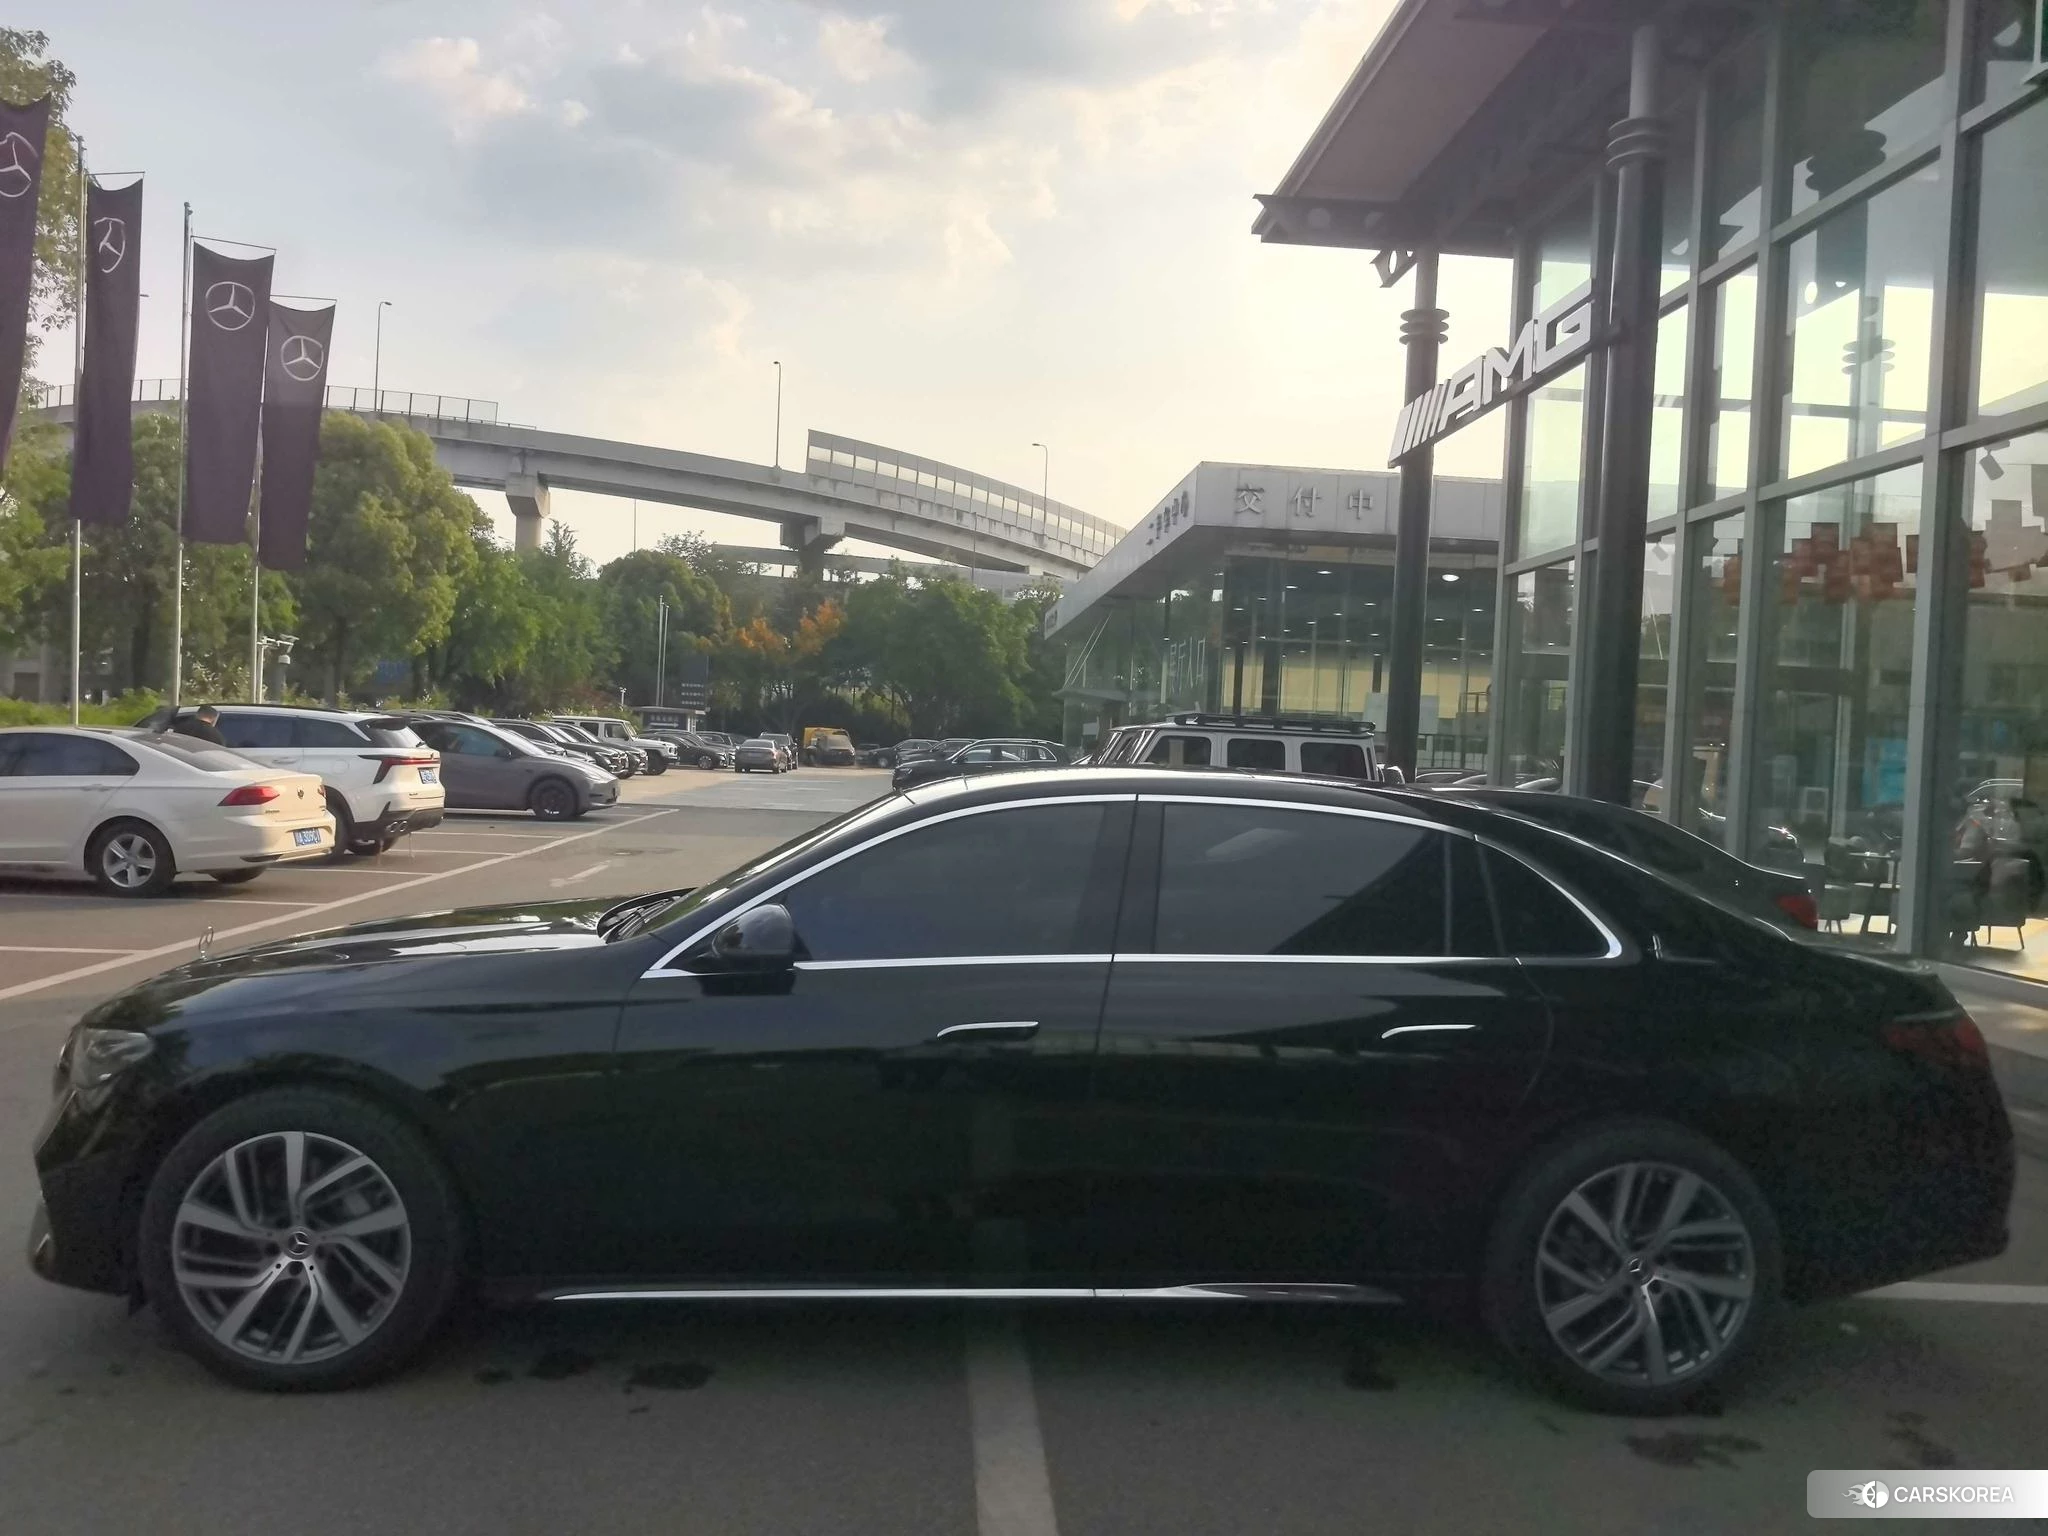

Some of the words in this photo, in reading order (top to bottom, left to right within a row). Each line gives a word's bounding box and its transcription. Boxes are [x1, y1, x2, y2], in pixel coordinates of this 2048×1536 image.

[1437, 277, 1592, 434] AMG
[1234, 482, 1375, 520] 交付中
